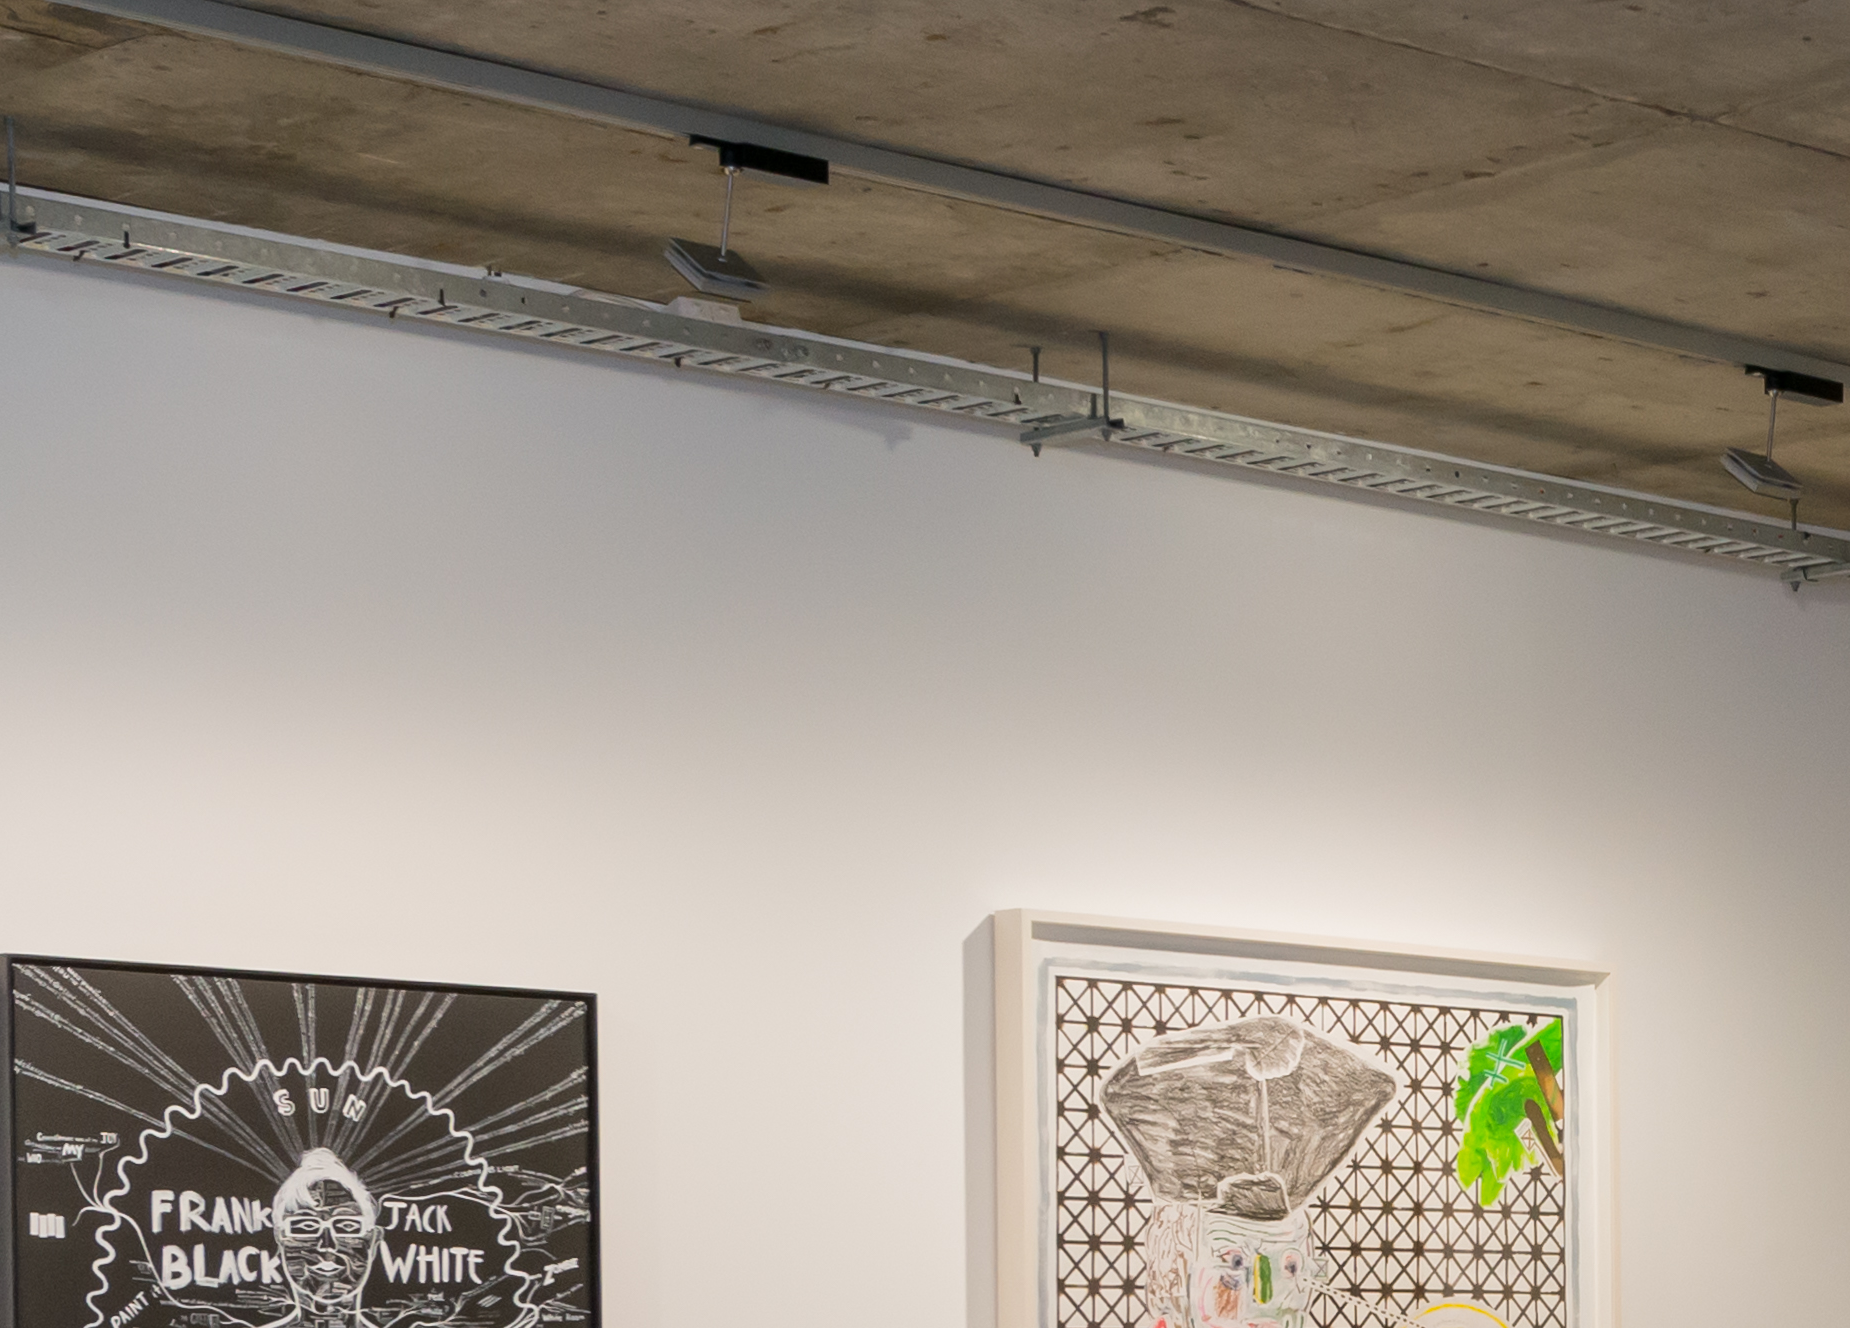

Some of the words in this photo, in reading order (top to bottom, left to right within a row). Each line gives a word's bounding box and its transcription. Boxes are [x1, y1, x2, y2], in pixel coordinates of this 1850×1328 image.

[273, 1088, 367, 1122] SUN
[151, 1189, 273, 1234] FRANK
[383, 1201, 452, 1234] JACK
[162, 1243, 283, 1290] BLACK
[380, 1240, 485, 1284] WHITE
